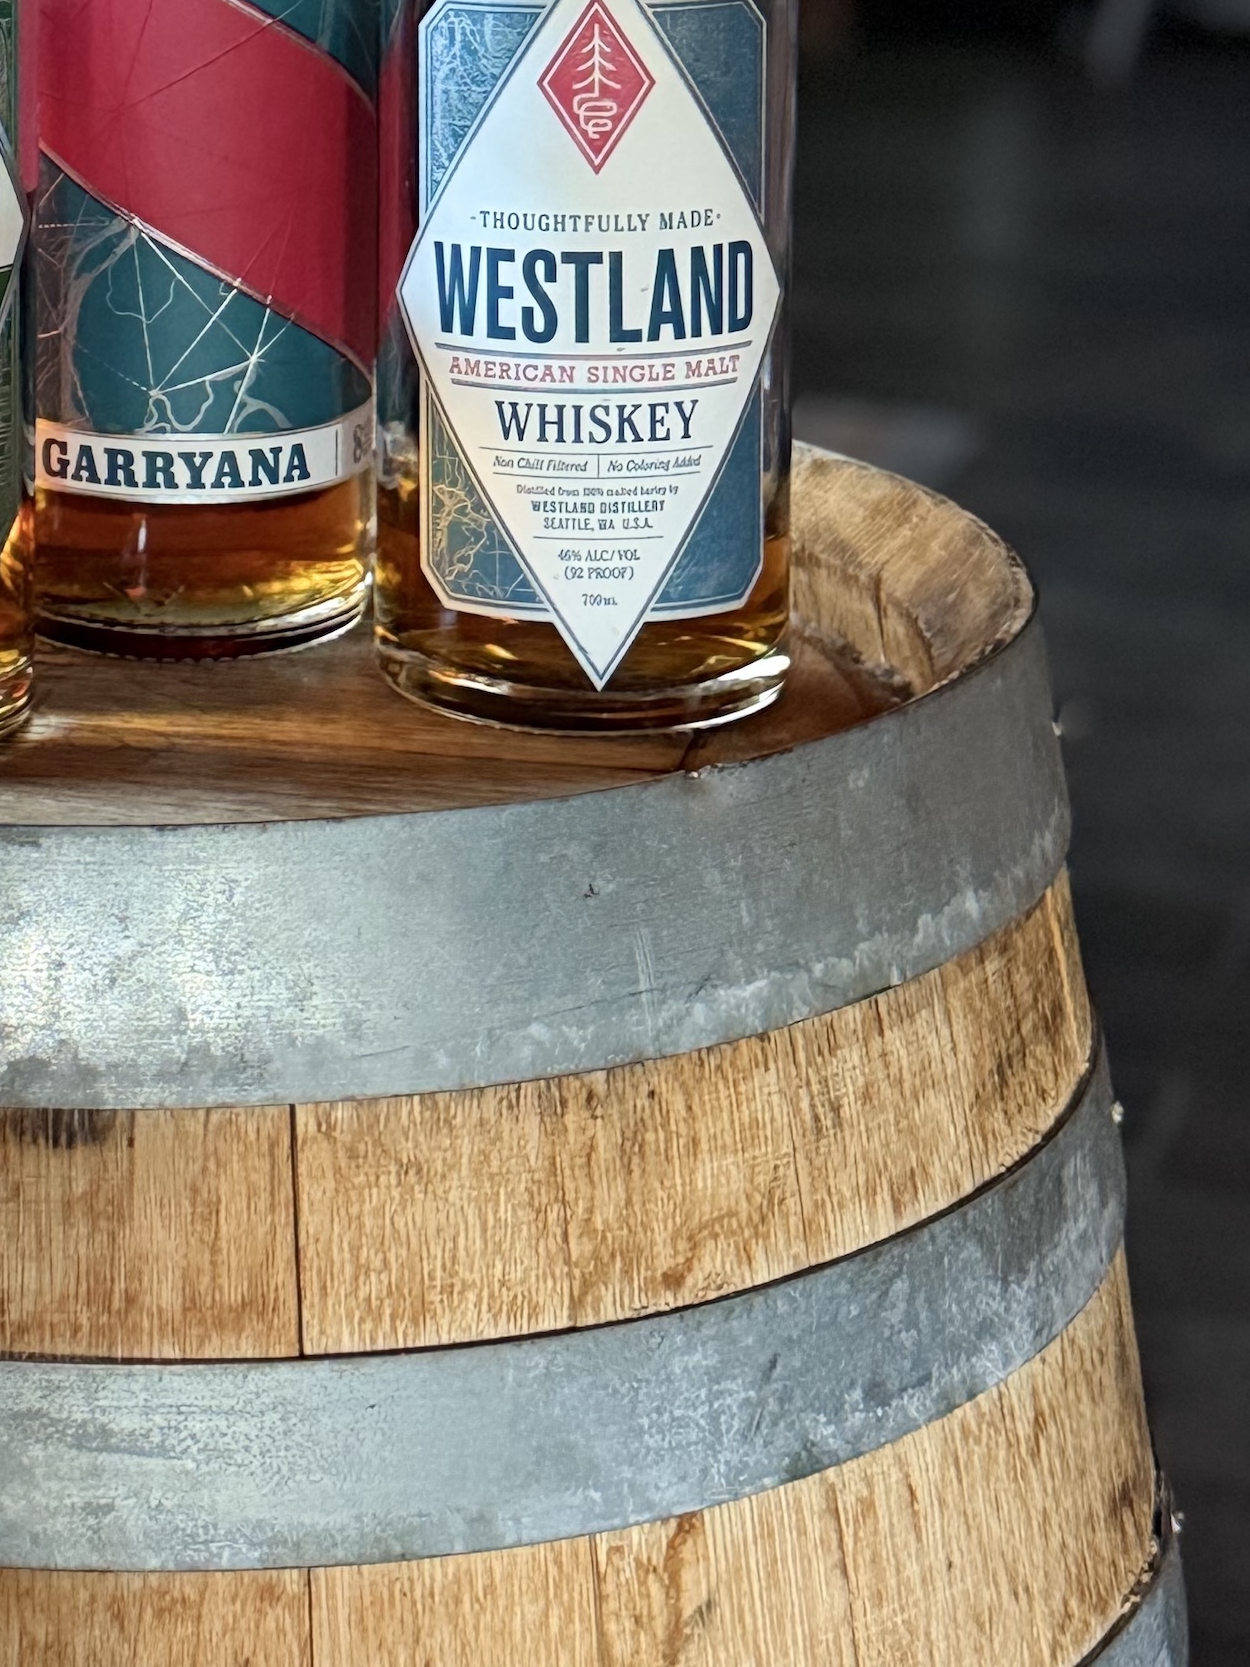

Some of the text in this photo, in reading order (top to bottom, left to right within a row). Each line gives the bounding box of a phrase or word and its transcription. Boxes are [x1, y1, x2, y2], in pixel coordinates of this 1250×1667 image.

[479, 208, 714, 233] THOUGHTFULLY MADE
[434, 240, 753, 343] WESTLAND
[449, 354, 741, 384] AMERICAN SINGLE MALT
[494, 399, 700, 445] WHISKEY
[42, 438, 311, 490] GARRYANA
[564, 566, 584, 581] (92
